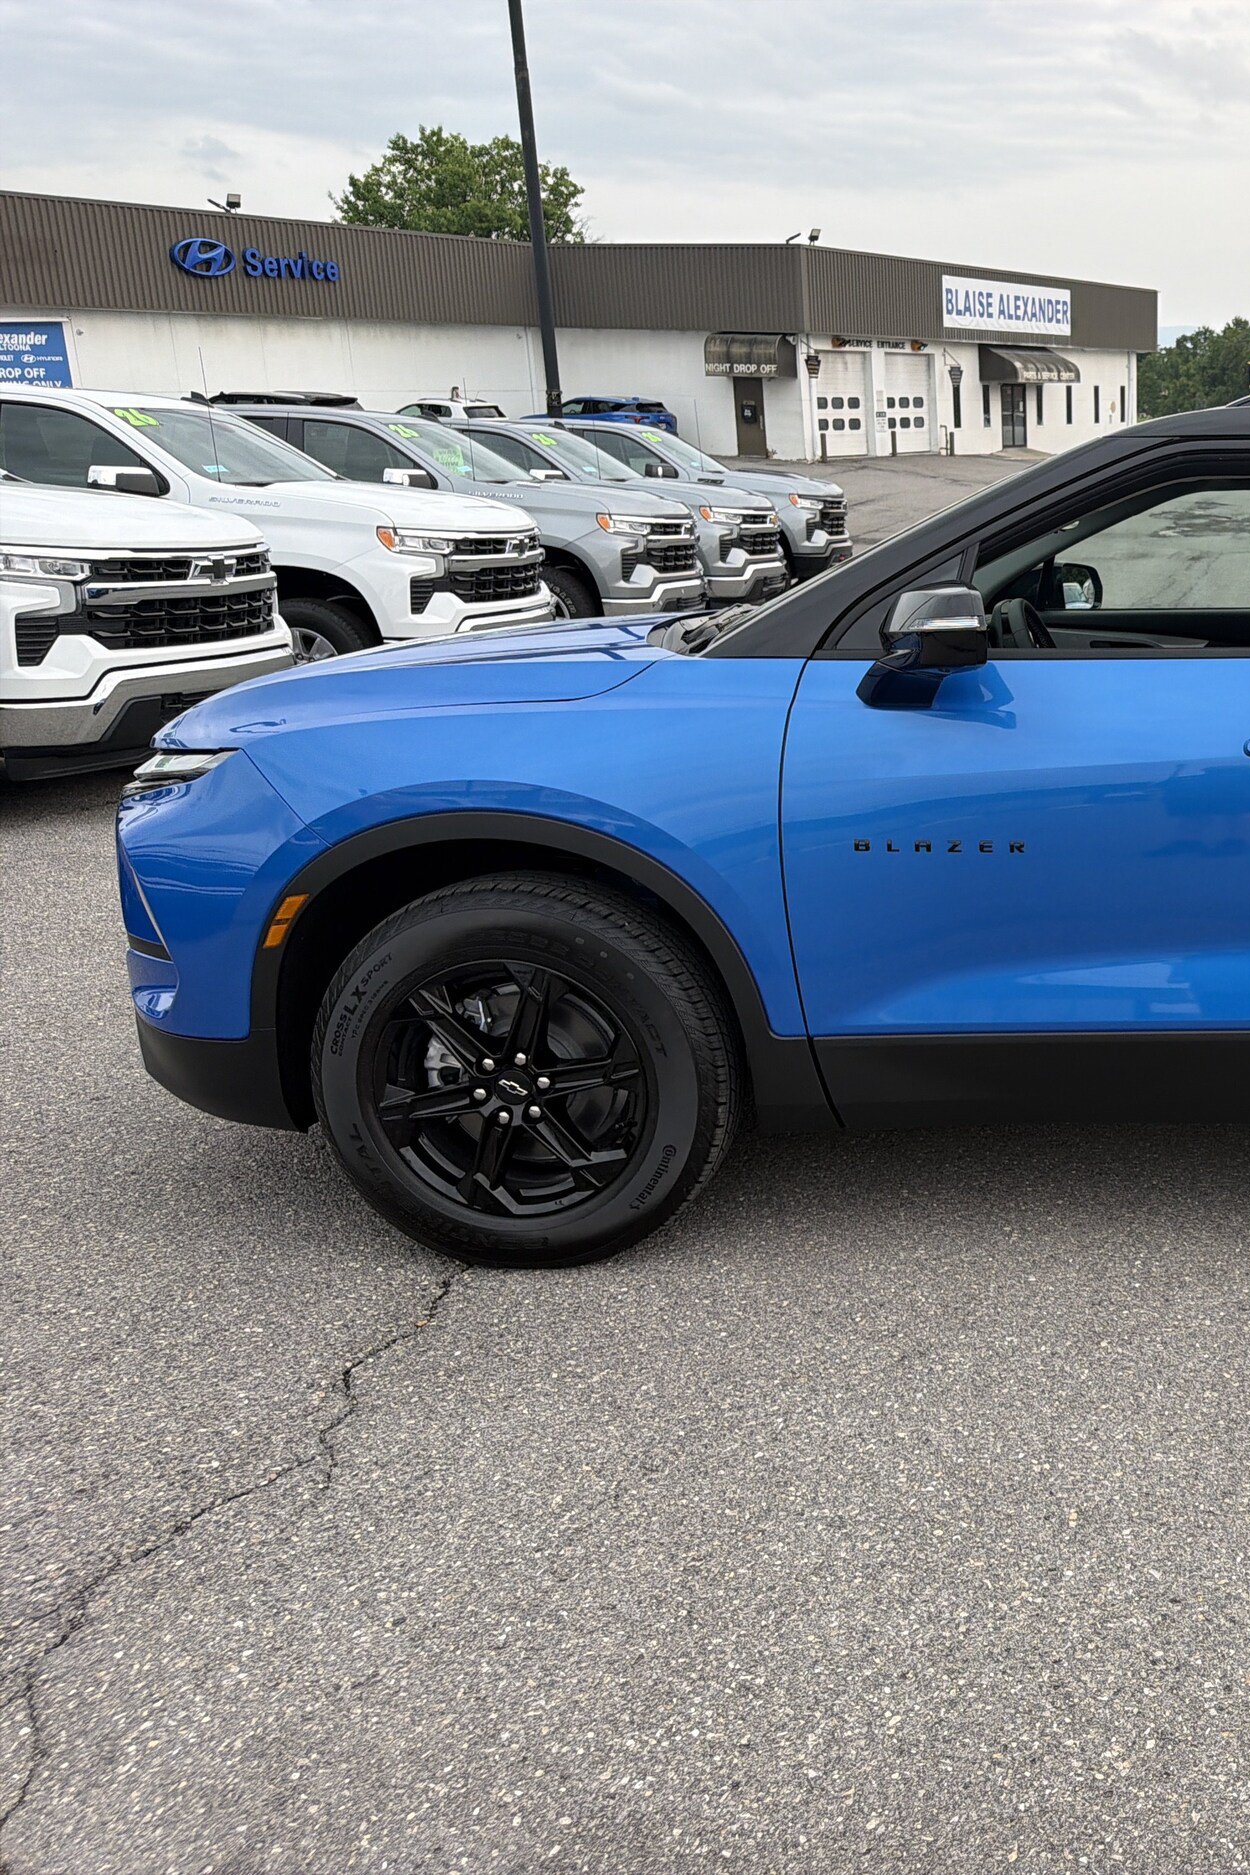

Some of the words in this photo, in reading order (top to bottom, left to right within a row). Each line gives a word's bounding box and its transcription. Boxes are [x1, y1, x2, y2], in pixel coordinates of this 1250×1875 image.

[242, 247, 341, 281] Service
[945, 288, 993, 319] BLAISE
[998, 293, 1069, 325] ALEXANDER
[24, 367, 46, 379] OFF
[705, 363, 731, 373] NIGHT
[734, 364, 757, 373] DROP
[760, 364, 777, 373] OFF
[854, 839, 1025, 853] BLAZER
[330, 1013, 347, 1055] CROSS
[343, 985, 367, 1016] LX
[361, 952, 392, 987] SPORT
[635, 1144, 677, 1205] Continental
